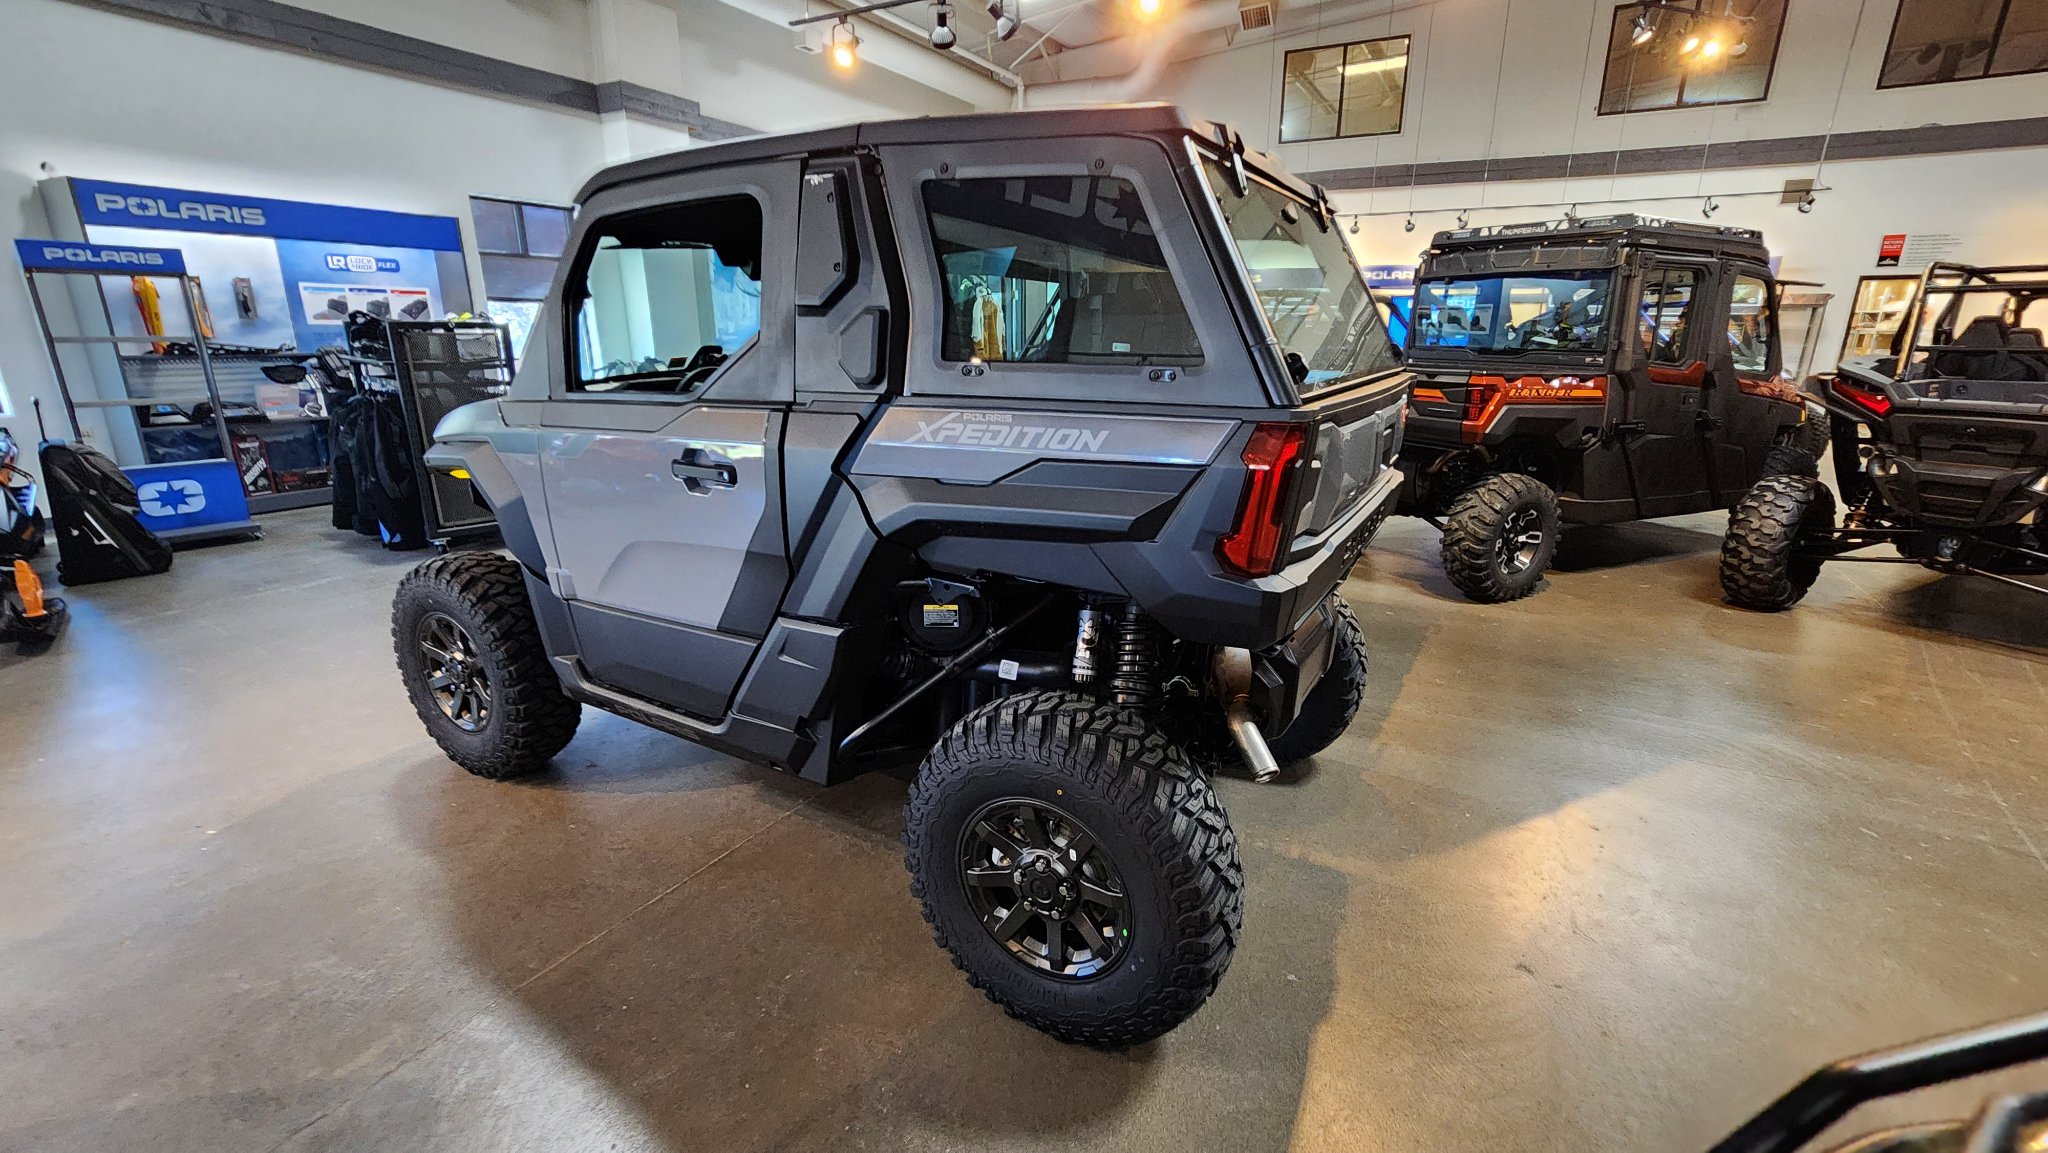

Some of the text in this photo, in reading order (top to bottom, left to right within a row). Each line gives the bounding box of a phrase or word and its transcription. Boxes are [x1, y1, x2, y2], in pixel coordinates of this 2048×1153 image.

[94, 193, 267, 226] POLARIS
[42, 247, 164, 265] POLARIS
[963, 412, 1013, 423] POLARIS
[903, 412, 1110, 452] XPEDITION
